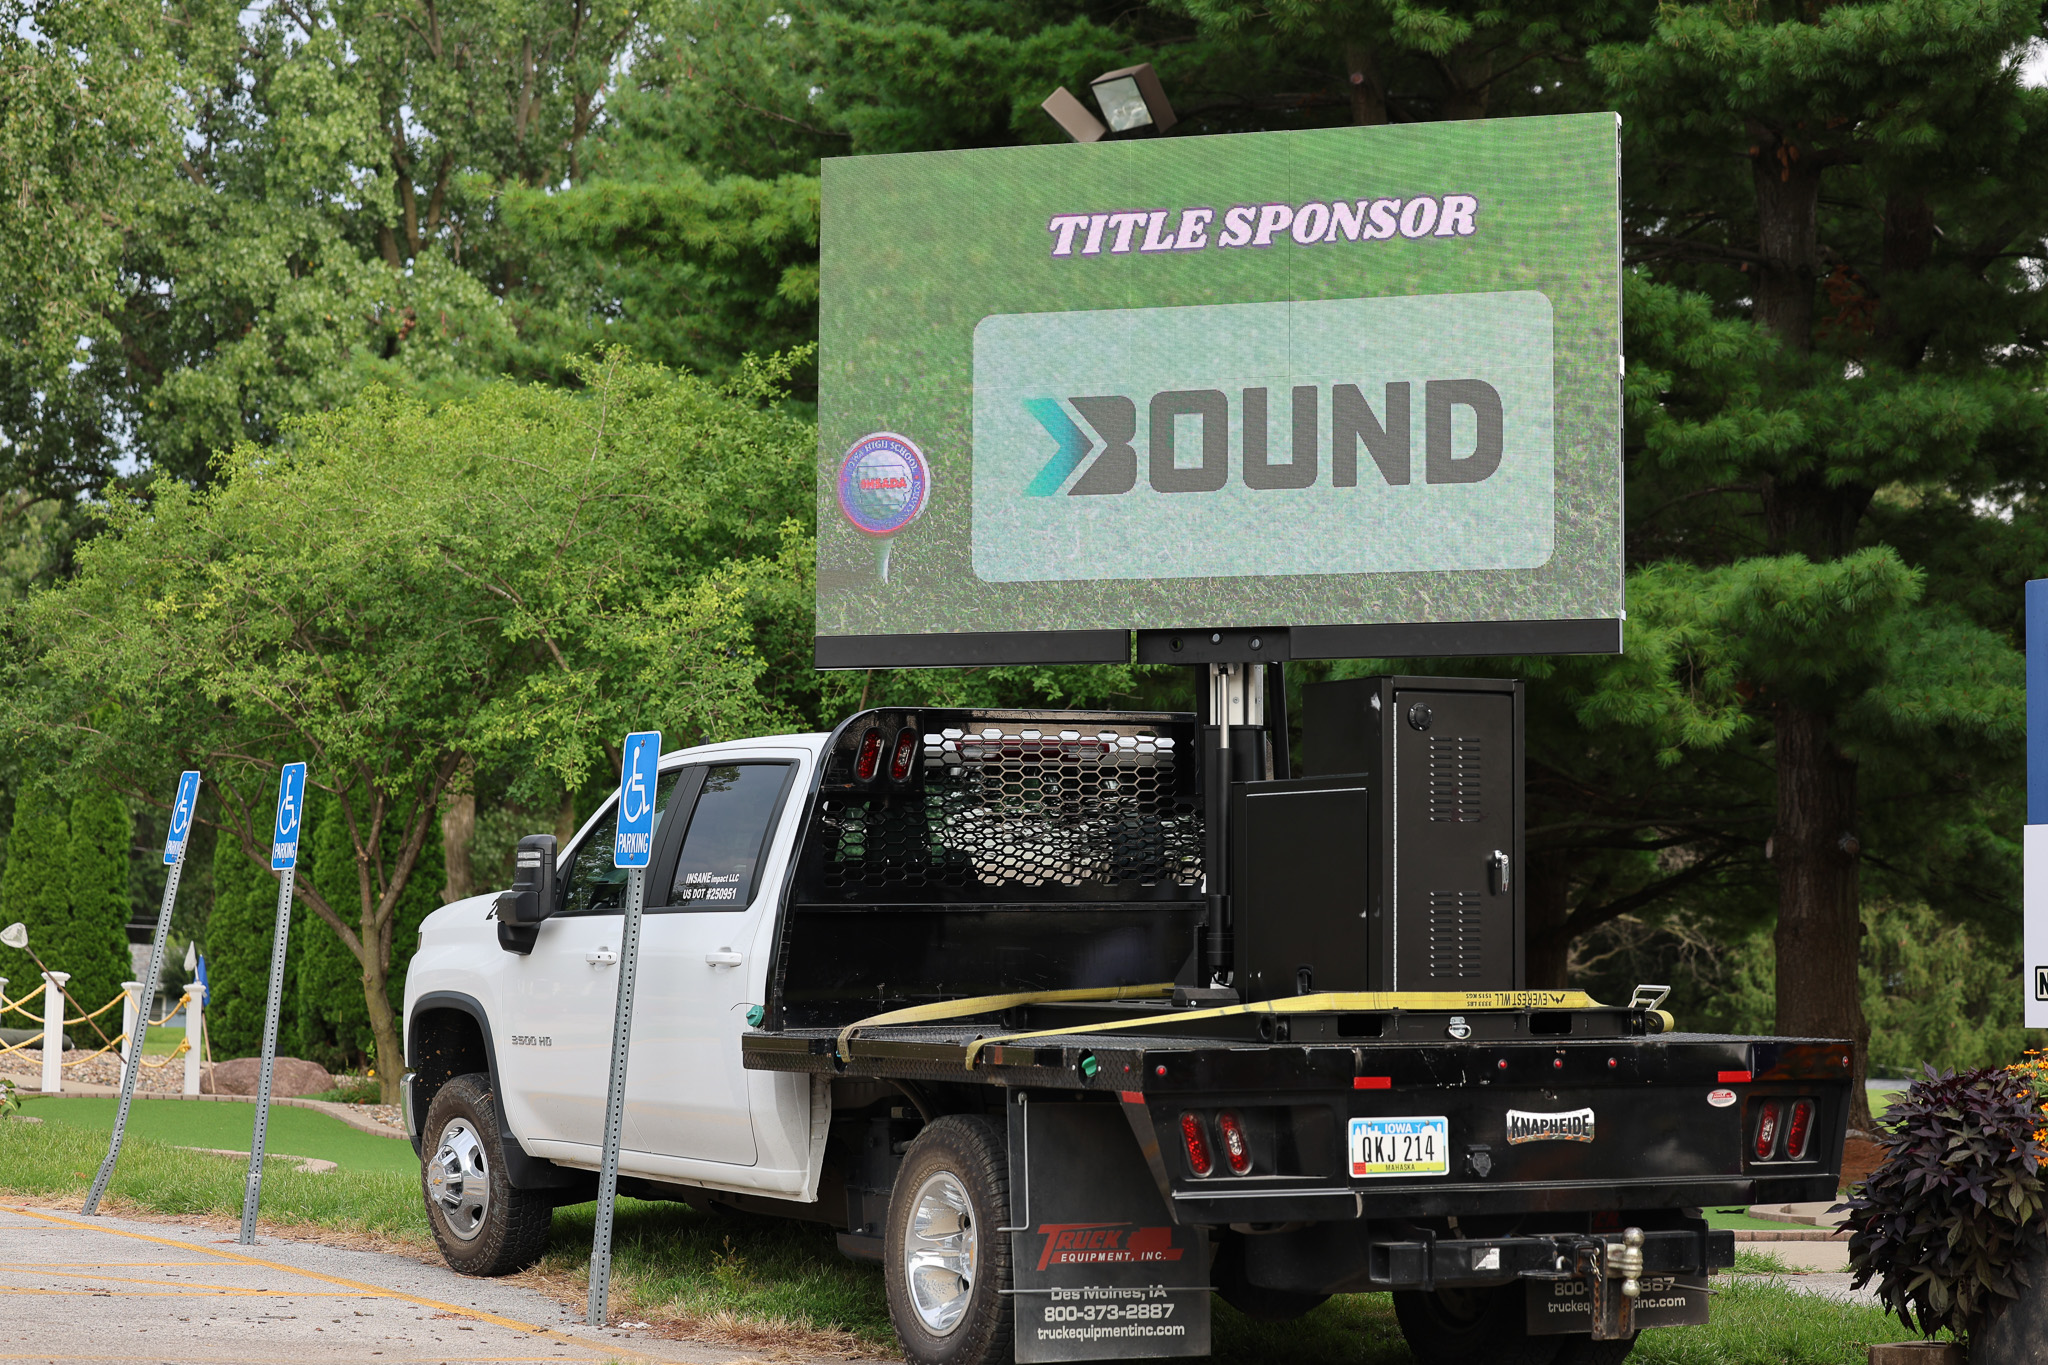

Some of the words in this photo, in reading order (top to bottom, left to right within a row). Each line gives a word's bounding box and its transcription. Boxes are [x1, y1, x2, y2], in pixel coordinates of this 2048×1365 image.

[1049, 209, 1214, 256] TITLE
[1218, 194, 1478, 248] SPONSOR
[1067, 378, 1503, 496] BOUND
[890, 440, 918, 472] SCHOOL
[273, 842, 296, 859] PARKING
[617, 833, 649, 854] PARKING
[686, 872, 712, 884] INSANE
[711, 875, 728, 885] impact
[729, 873, 740, 883] LLC
[683, 889, 692, 900] US
[692, 888, 706, 899] DOT
[706, 887, 737, 900] #250951
[1495, 993, 1511, 1007] WLL
[1512, 992, 1548, 1006] EVEREST
[512, 1035, 537, 1046] 3500
[539, 1036, 552, 1047] HD
[1384, 1123, 1413, 1134] IOWA
[1511, 1114, 1590, 1139] KNAPHEIDE
[1362, 1136, 1396, 1163] QKJ
[1403, 1135, 1435, 1162] 214
[1036, 1222, 1128, 1270] TRUCK
[1061, 1252, 1135, 1263] EQUIPMENT,
[1141, 1251, 1167, 1261] INC.
[1051, 1287, 1080, 1301] Des
[1084, 1286, 1146, 1301] Moines,
[1149, 1284, 1167, 1298] IA
[1044, 1304, 1175, 1322] 800-373-2887
[1037, 1323, 1185, 1342] truckequipmentinc.com
